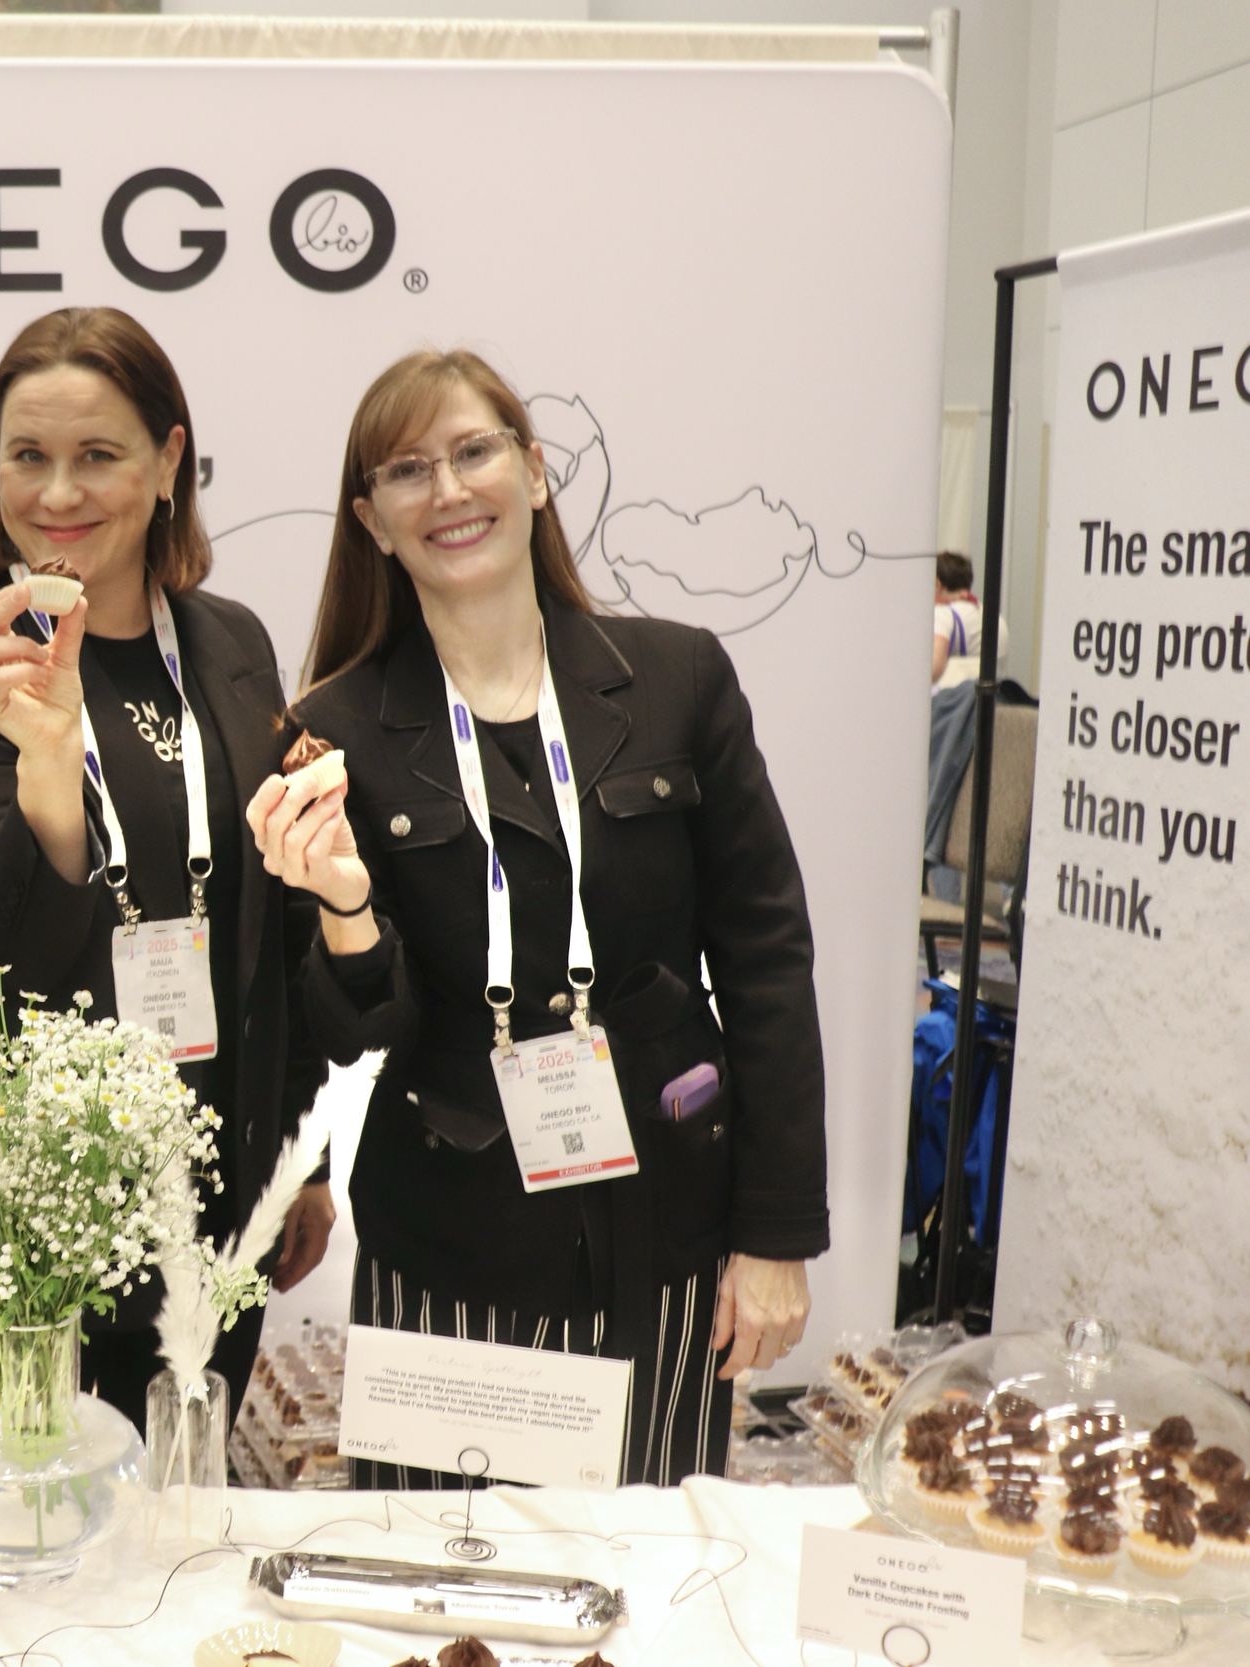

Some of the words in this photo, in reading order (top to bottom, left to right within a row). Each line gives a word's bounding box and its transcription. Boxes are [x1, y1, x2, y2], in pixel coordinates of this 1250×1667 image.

[296, 194, 369, 254] bio
[1080, 519, 1147, 576] The
[1161, 529, 1250, 577] sma
[1073, 618, 1143, 678] egg
[1157, 612, 1250, 681] prot
[1068, 692, 1098, 748] is
[1111, 699, 1240, 767] closer
[1063, 779, 1145, 846] than
[1158, 805, 1236, 864] you
[1057, 862, 1163, 941] think.
[147, 937, 178, 954] 2025
[150, 957, 173, 968] MAIJA
[143, 993, 170, 1003] ONEGO
[172, 991, 186, 1000] BIO
[536, 1050, 574, 1070] 2025
[537, 1069, 576, 1085] MELISSA
[544, 1082, 576, 1096] TOROK
[540, 1109, 573, 1122] ONEGO
[575, 1104, 591, 1115] BIO
[536, 1124, 551, 1133] SAN
[552, 1118, 576, 1130] DIEGO
[558, 1162, 603, 1178] EXHIBITOR
[877, 1556, 928, 1574] ONEGO
[853, 1573, 888, 1589] Vanilla
[889, 1580, 940, 1599] Cupcakes
[942, 1590, 966, 1604] with
[847, 1586, 871, 1600] Dark
[874, 1591, 924, 1611] Chocolate
[926, 1602, 970, 1621] Frosting
